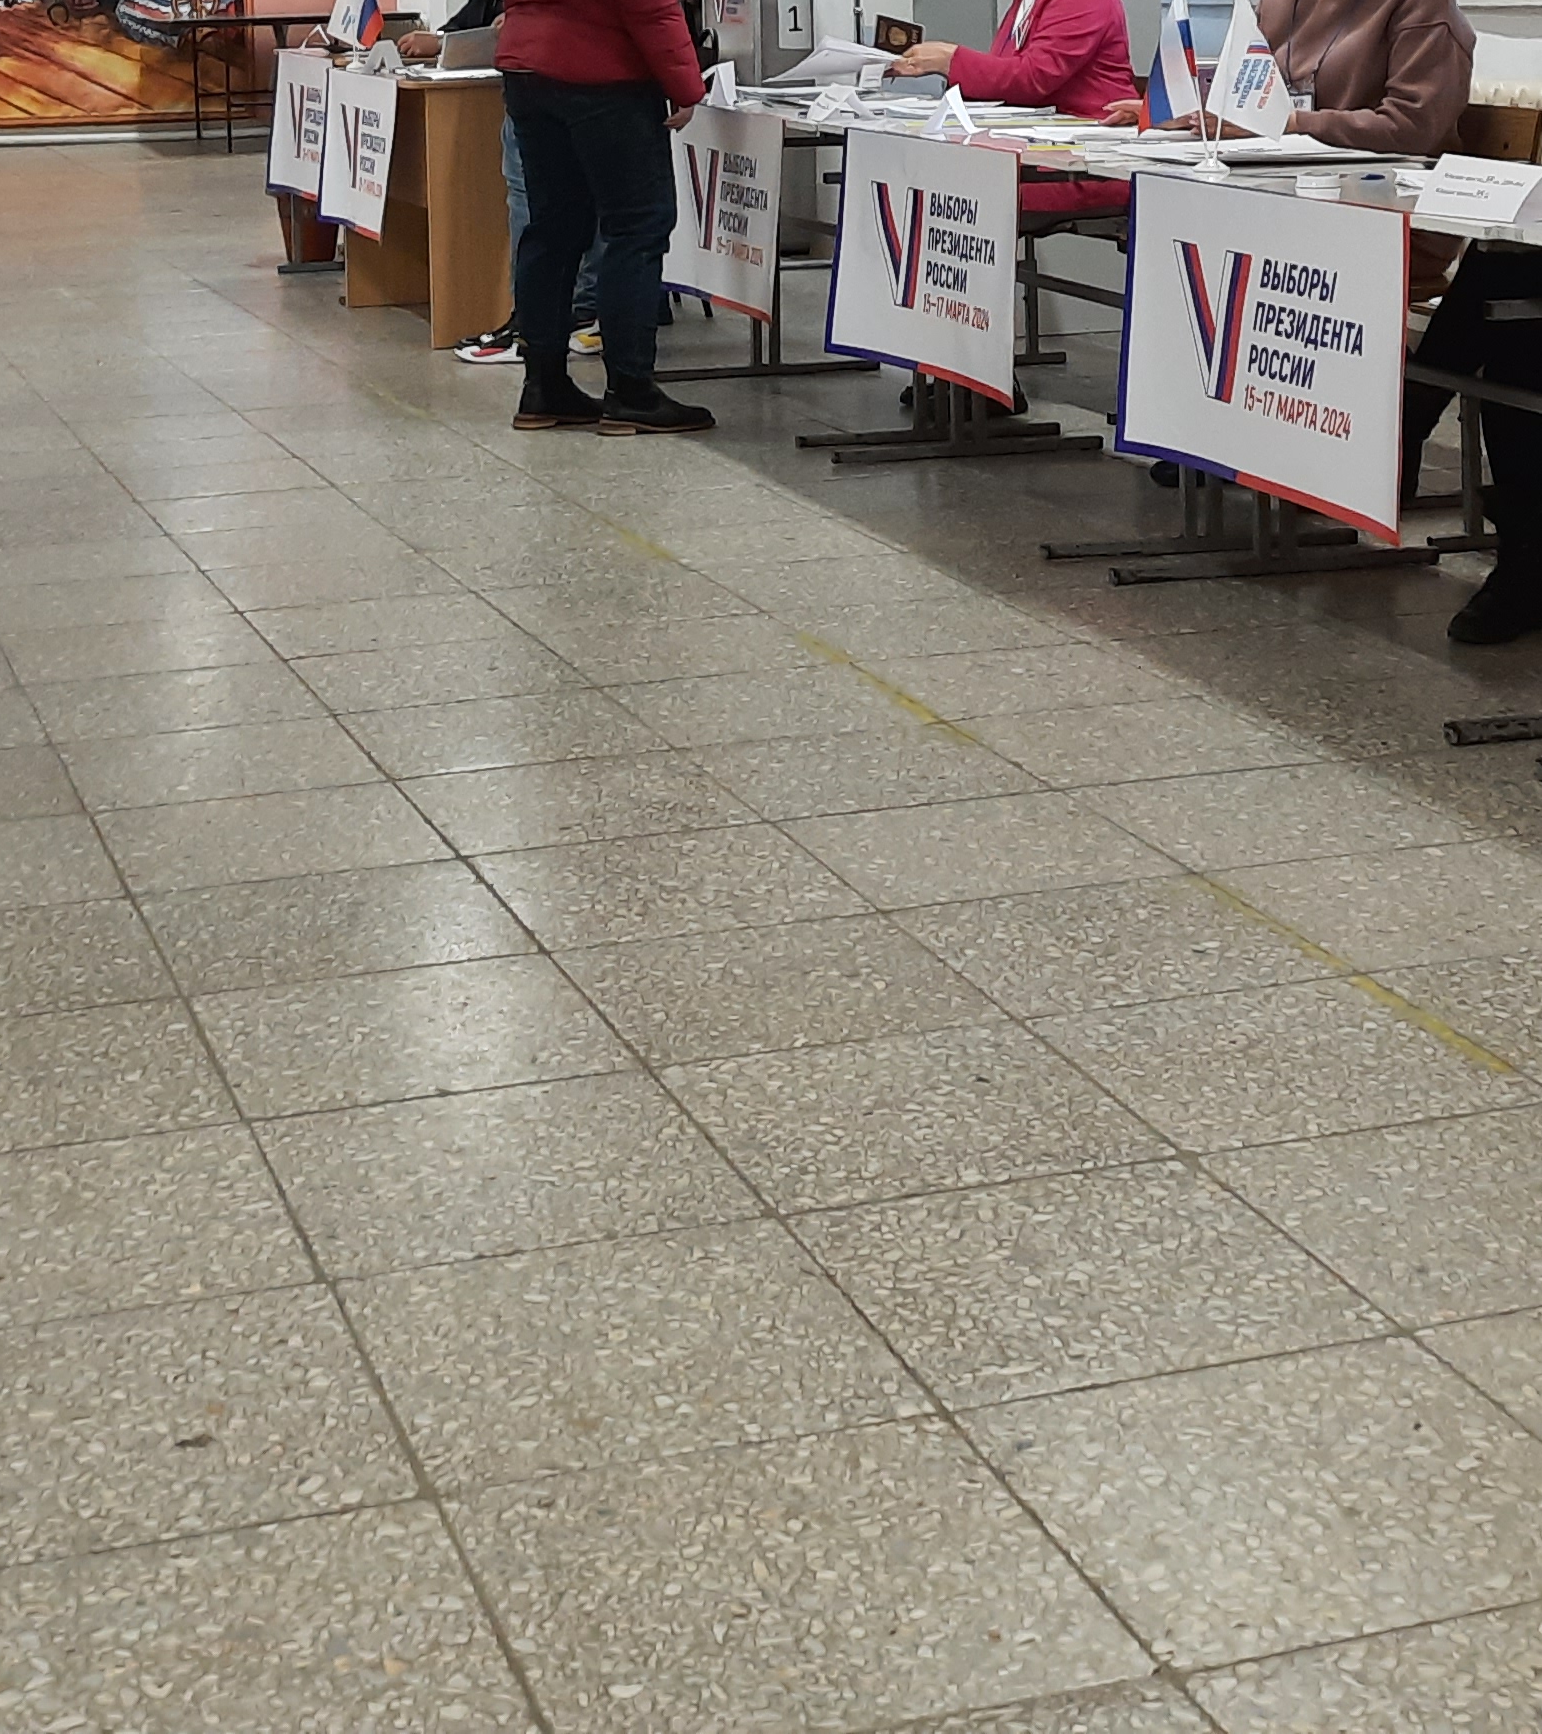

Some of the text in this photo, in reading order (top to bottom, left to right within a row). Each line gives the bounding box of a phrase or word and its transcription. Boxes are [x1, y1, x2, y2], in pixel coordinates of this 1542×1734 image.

[787, 6, 803, 32] 1
[929, 192, 978, 226] ВЫБОРЫ
[927, 226, 996, 266] ПРЕЗИДЕНТА
[925, 260, 968, 294] РОССИИ
[1259, 258, 1338, 303] ВЫБОРЫ
[945, 298, 970, 325] МАРТА
[1253, 301, 1364, 356] ПРЕЗИДЕНТА
[1247, 344, 1316, 390] РОССИИ
[1276, 394, 1317, 431] МАРТА
[1320, 406, 1352, 441] 2024
